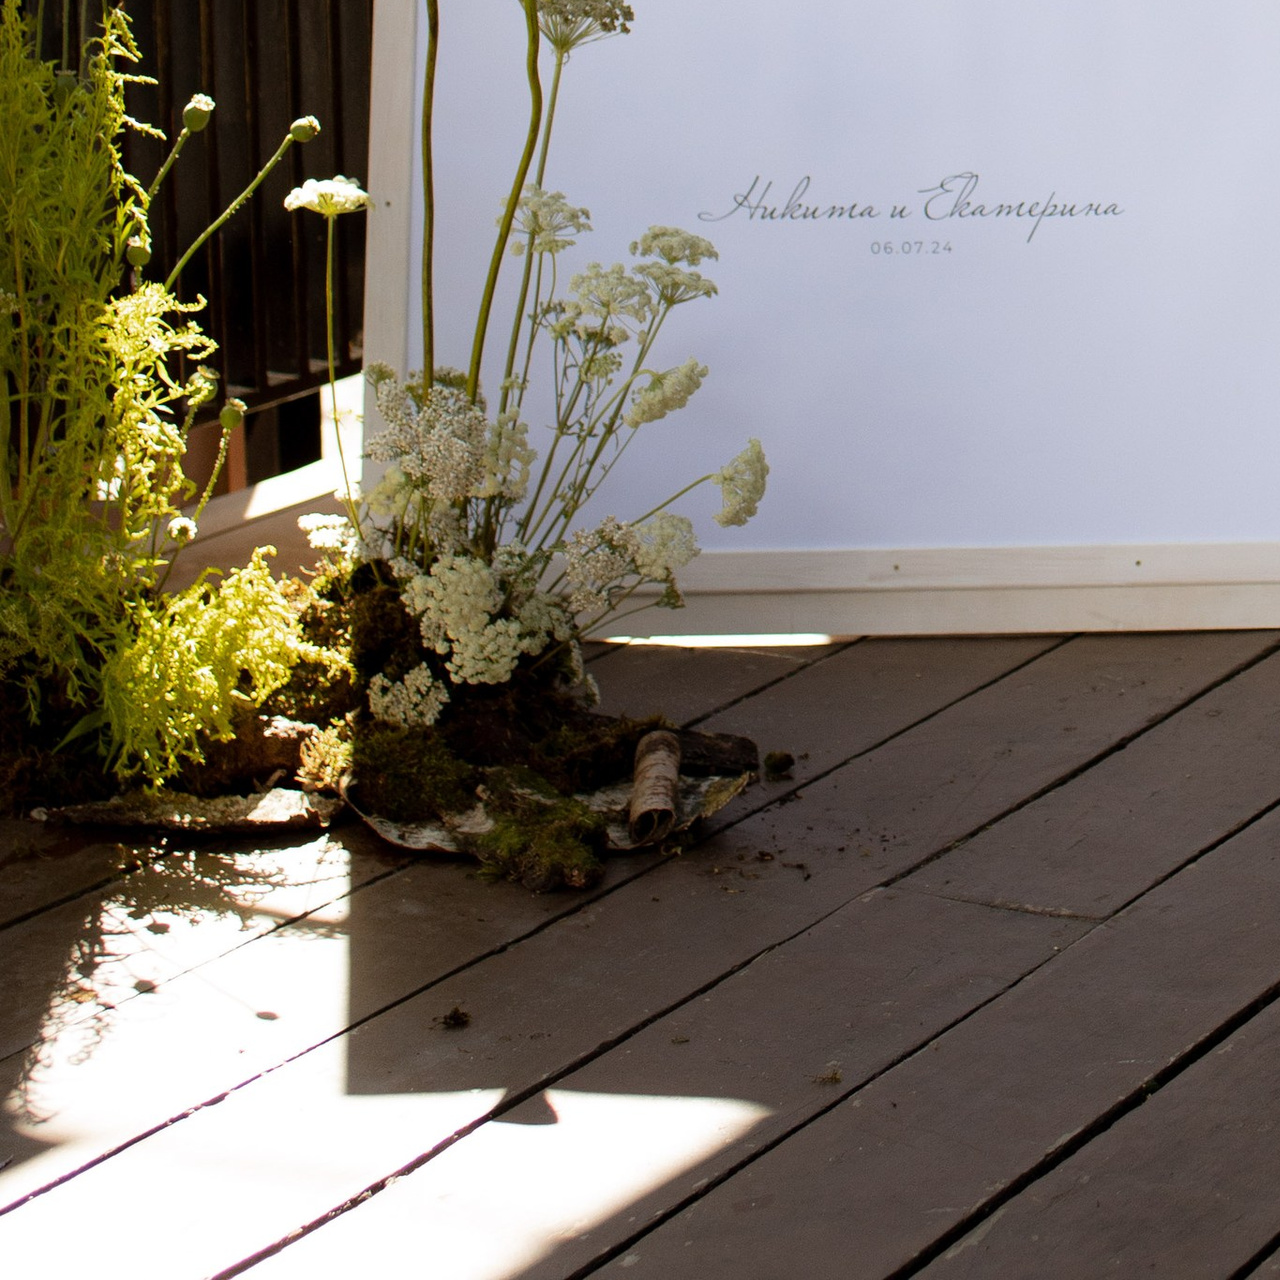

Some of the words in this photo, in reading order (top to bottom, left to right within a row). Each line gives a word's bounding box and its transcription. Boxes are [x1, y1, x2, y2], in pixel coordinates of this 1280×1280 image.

[697, 175, 880, 222] Никита
[889, 202, 912, 220] и
[916, 171, 1125, 244] Екатерина
[869, 240, 953, 256] 06.07.24
